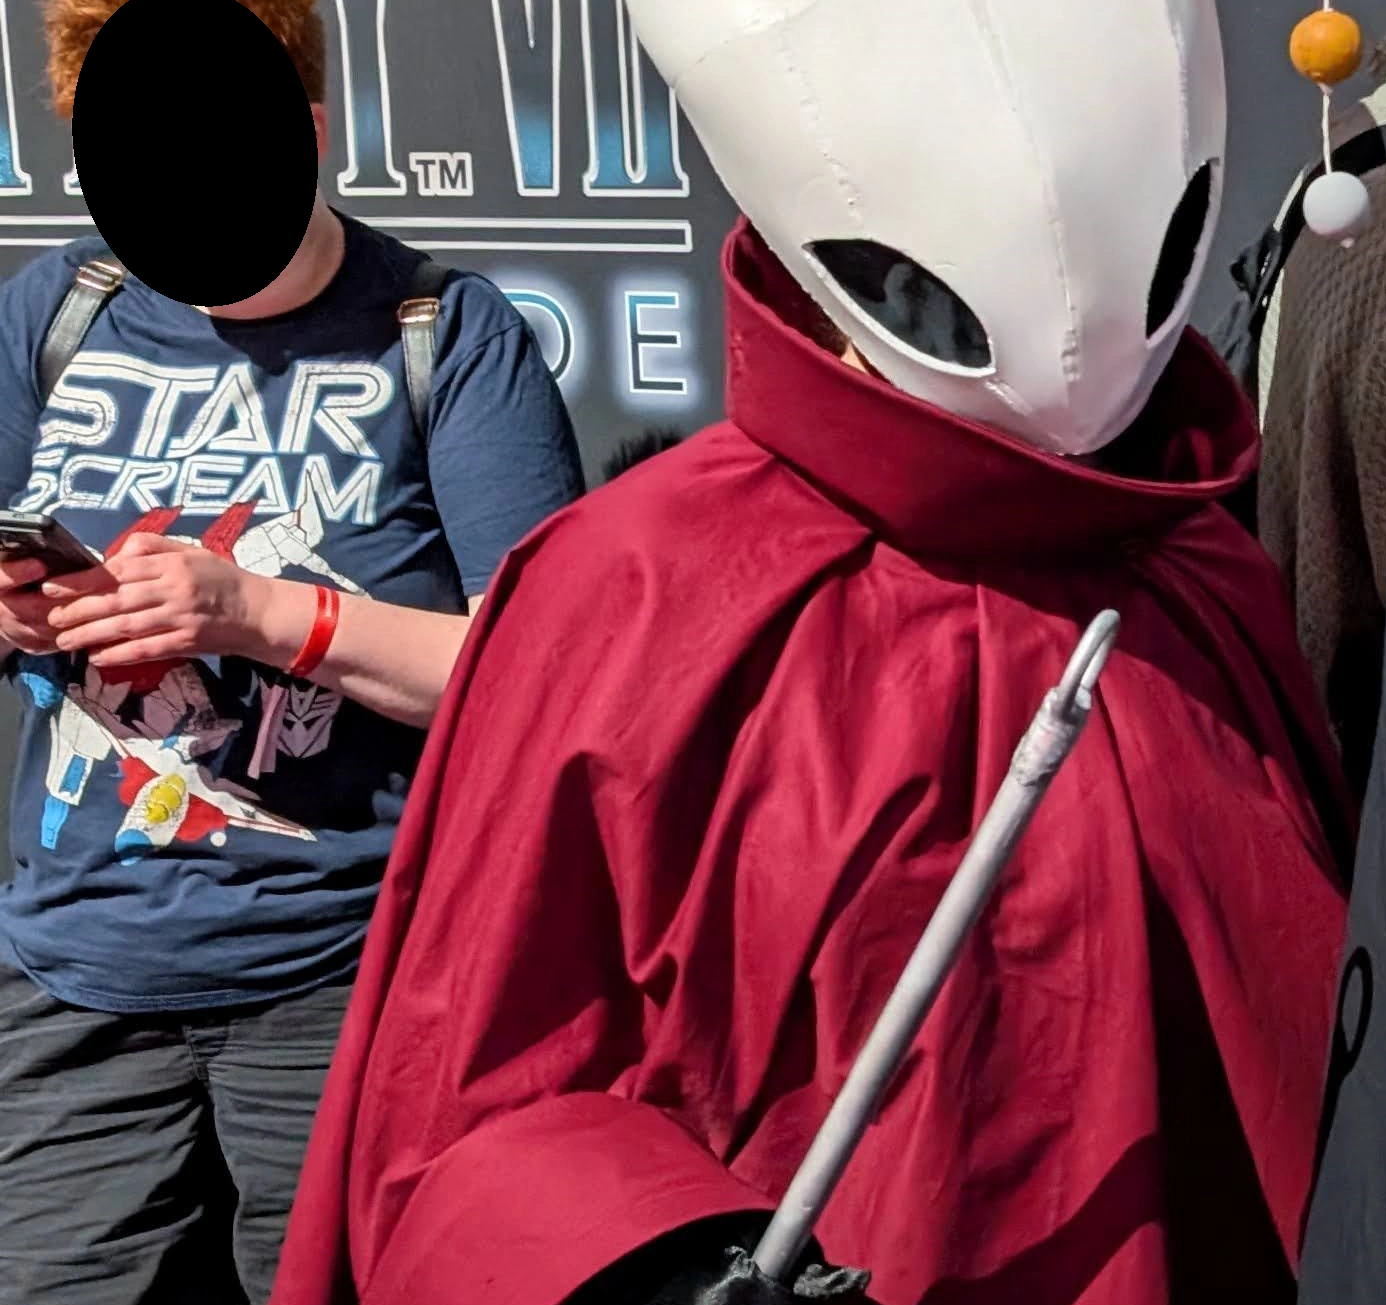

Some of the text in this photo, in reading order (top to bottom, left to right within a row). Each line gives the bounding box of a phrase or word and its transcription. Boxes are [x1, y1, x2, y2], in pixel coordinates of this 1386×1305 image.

[409, 152, 474, 196] TM
[37, 351, 395, 460] STAR
[8, 445, 385, 525] SCREAM
